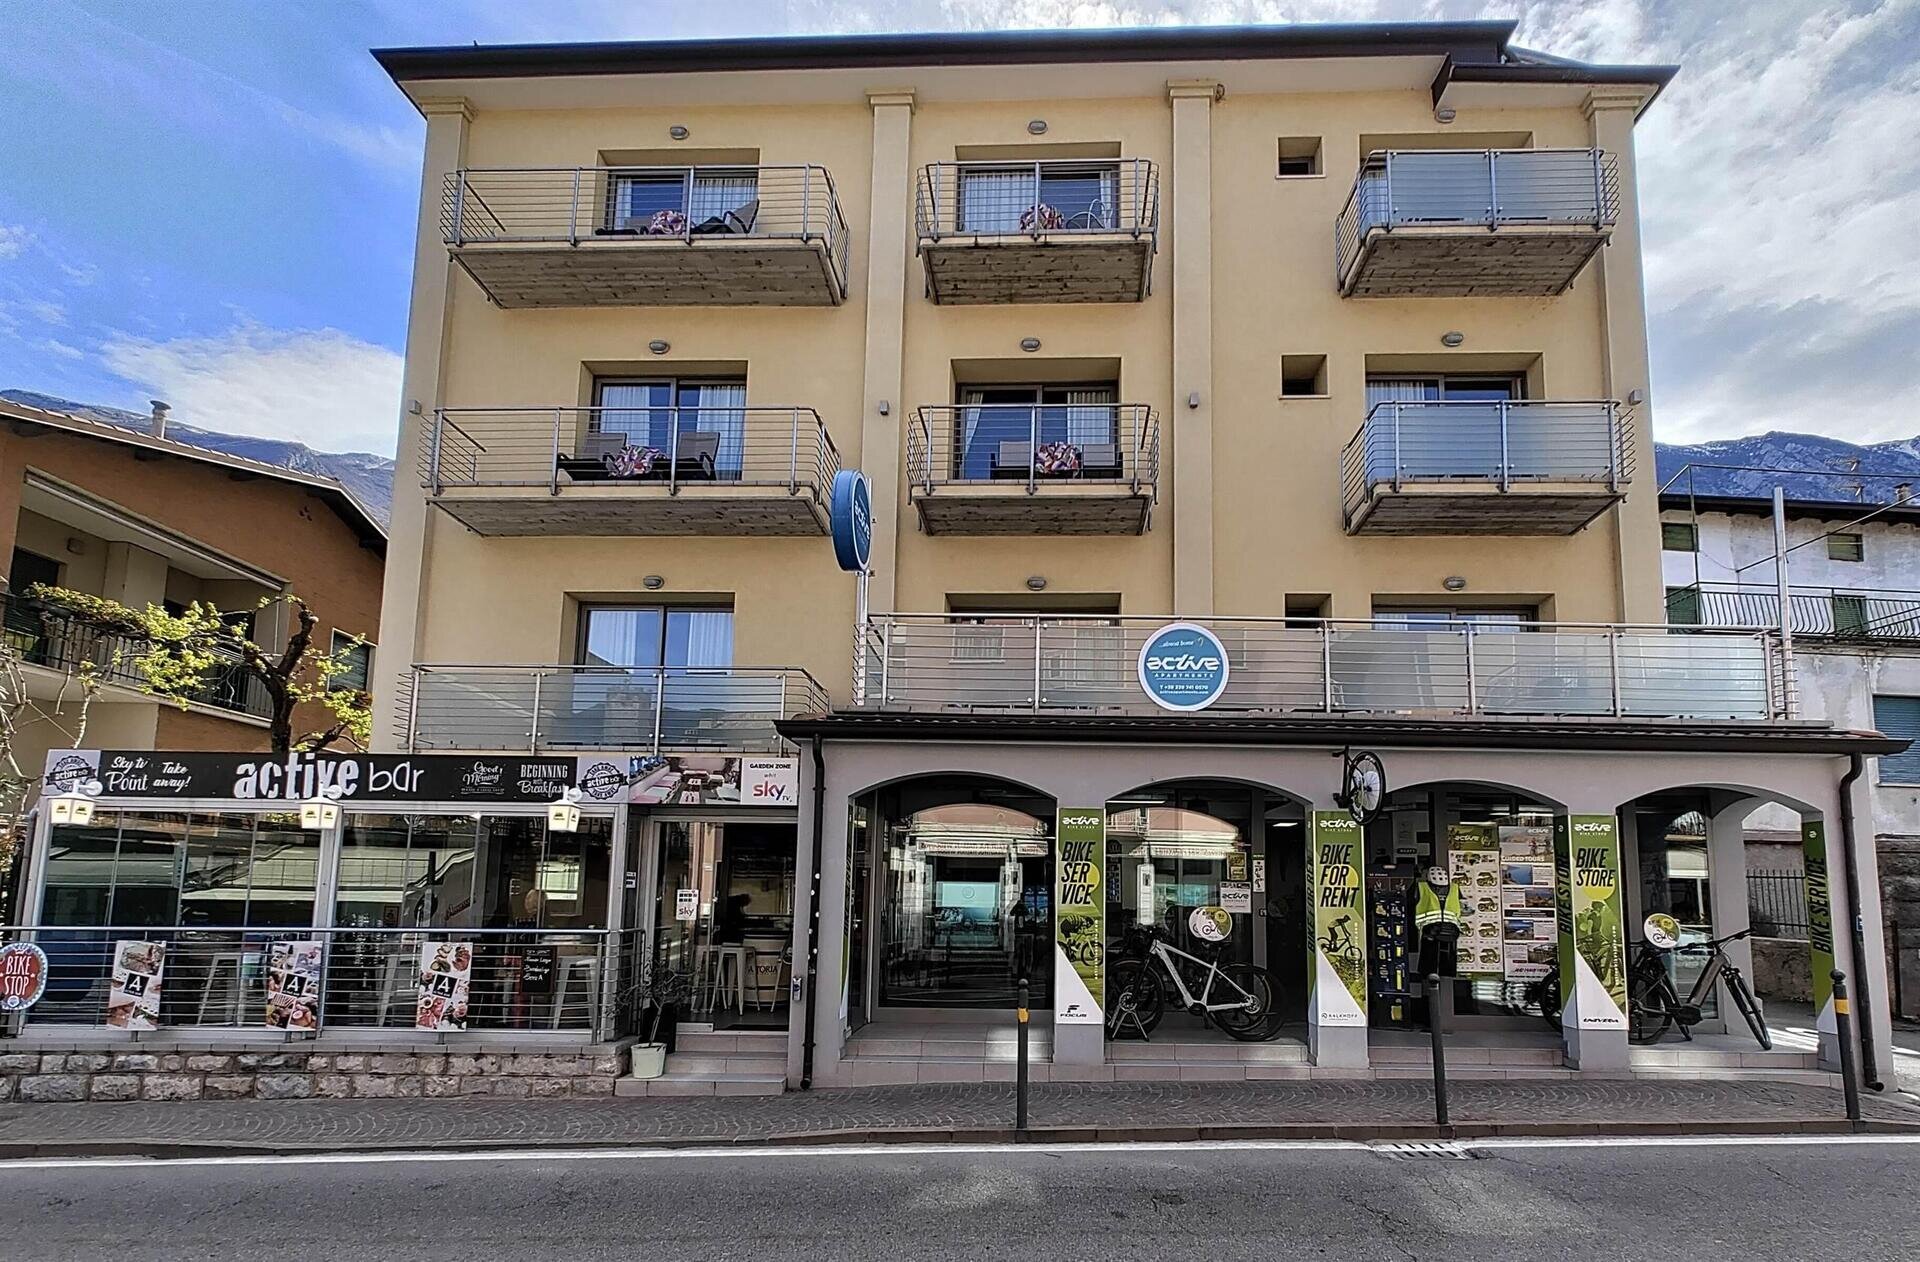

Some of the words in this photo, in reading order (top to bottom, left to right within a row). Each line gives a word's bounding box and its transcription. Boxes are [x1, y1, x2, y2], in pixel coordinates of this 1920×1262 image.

[1146, 654, 1220, 670] active
[111, 756, 134, 774] Sky
[162, 762, 188, 774] Take
[474, 761, 498, 773] Good
[520, 764, 568, 778] BEGINNING
[55, 769, 77, 780] active
[106, 772, 148, 791] Point
[234, 752, 359, 799] active
[368, 761, 424, 792] bar
[587, 776, 609, 787] active
[153, 776, 191, 792] away!
[753, 781, 786, 800] sky
[1062, 816, 1100, 825] active
[1320, 819, 1357, 828] active
[1574, 823, 1611, 832] active
[1061, 841, 1096, 862] BIKE
[1320, 845, 1354, 864] BIKE
[1576, 848, 1609, 868] BIKE
[1061, 863, 1090, 883] SER
[1320, 866, 1349, 886] FOR
[1557, 852, 1570, 898] STORE
[1576, 870, 1616, 887] STORE
[1062, 884, 1094, 904] VICE
[1806, 855, 1830, 917] SERVICE
[1320, 887, 1359, 907] RENT
[679, 906, 694, 916] sky
[1558, 901, 1572, 936] BIKE
[1811, 918, 1832, 954] BIKE
[6, 956, 31, 975] BIKE
[4, 977, 29, 996] STOP
[128, 976, 141, 991] A
[287, 976, 299, 992] A
[437, 977, 450, 992] A
